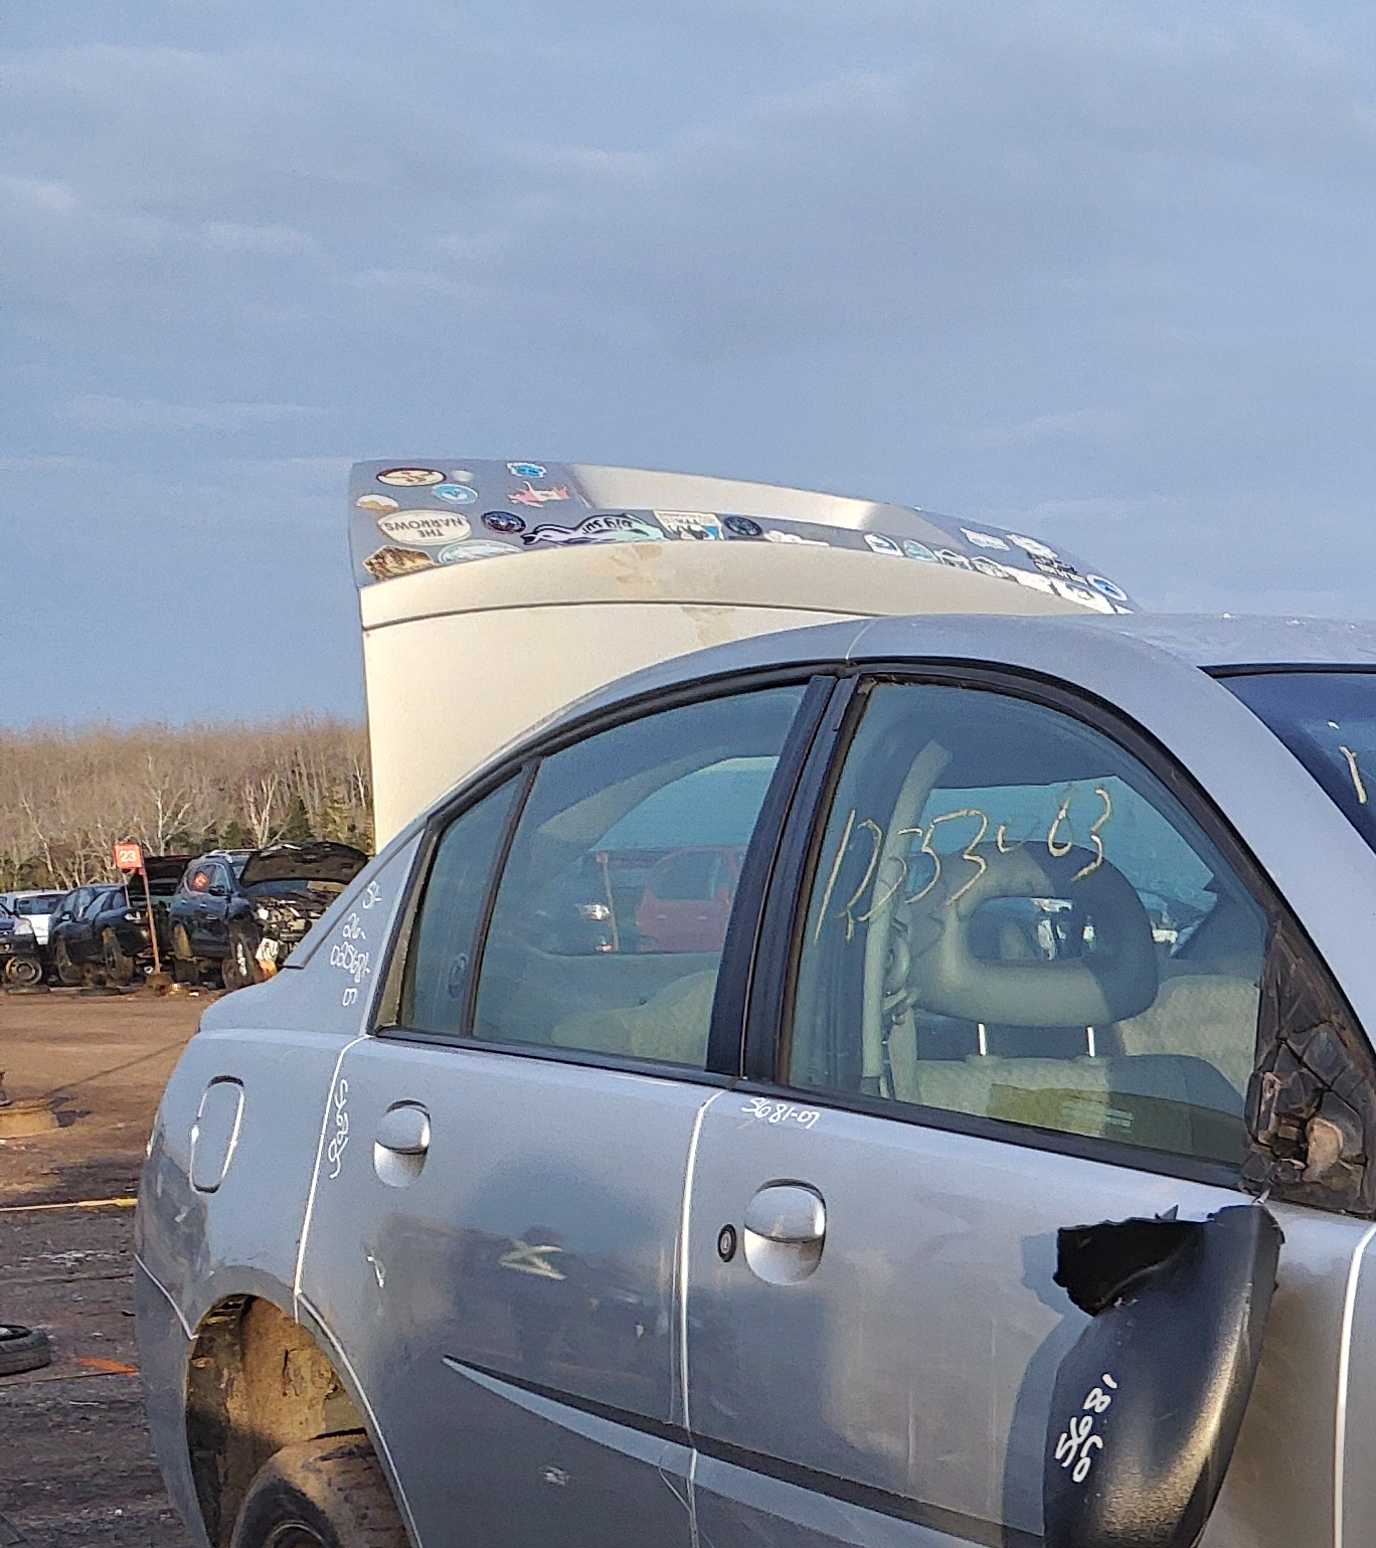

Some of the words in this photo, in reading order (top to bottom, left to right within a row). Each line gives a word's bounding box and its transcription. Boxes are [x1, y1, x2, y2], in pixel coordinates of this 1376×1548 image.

[385, 517, 464, 532] NARROWS
[419, 529, 444, 538] THE
[119, 850, 137, 864] 23
